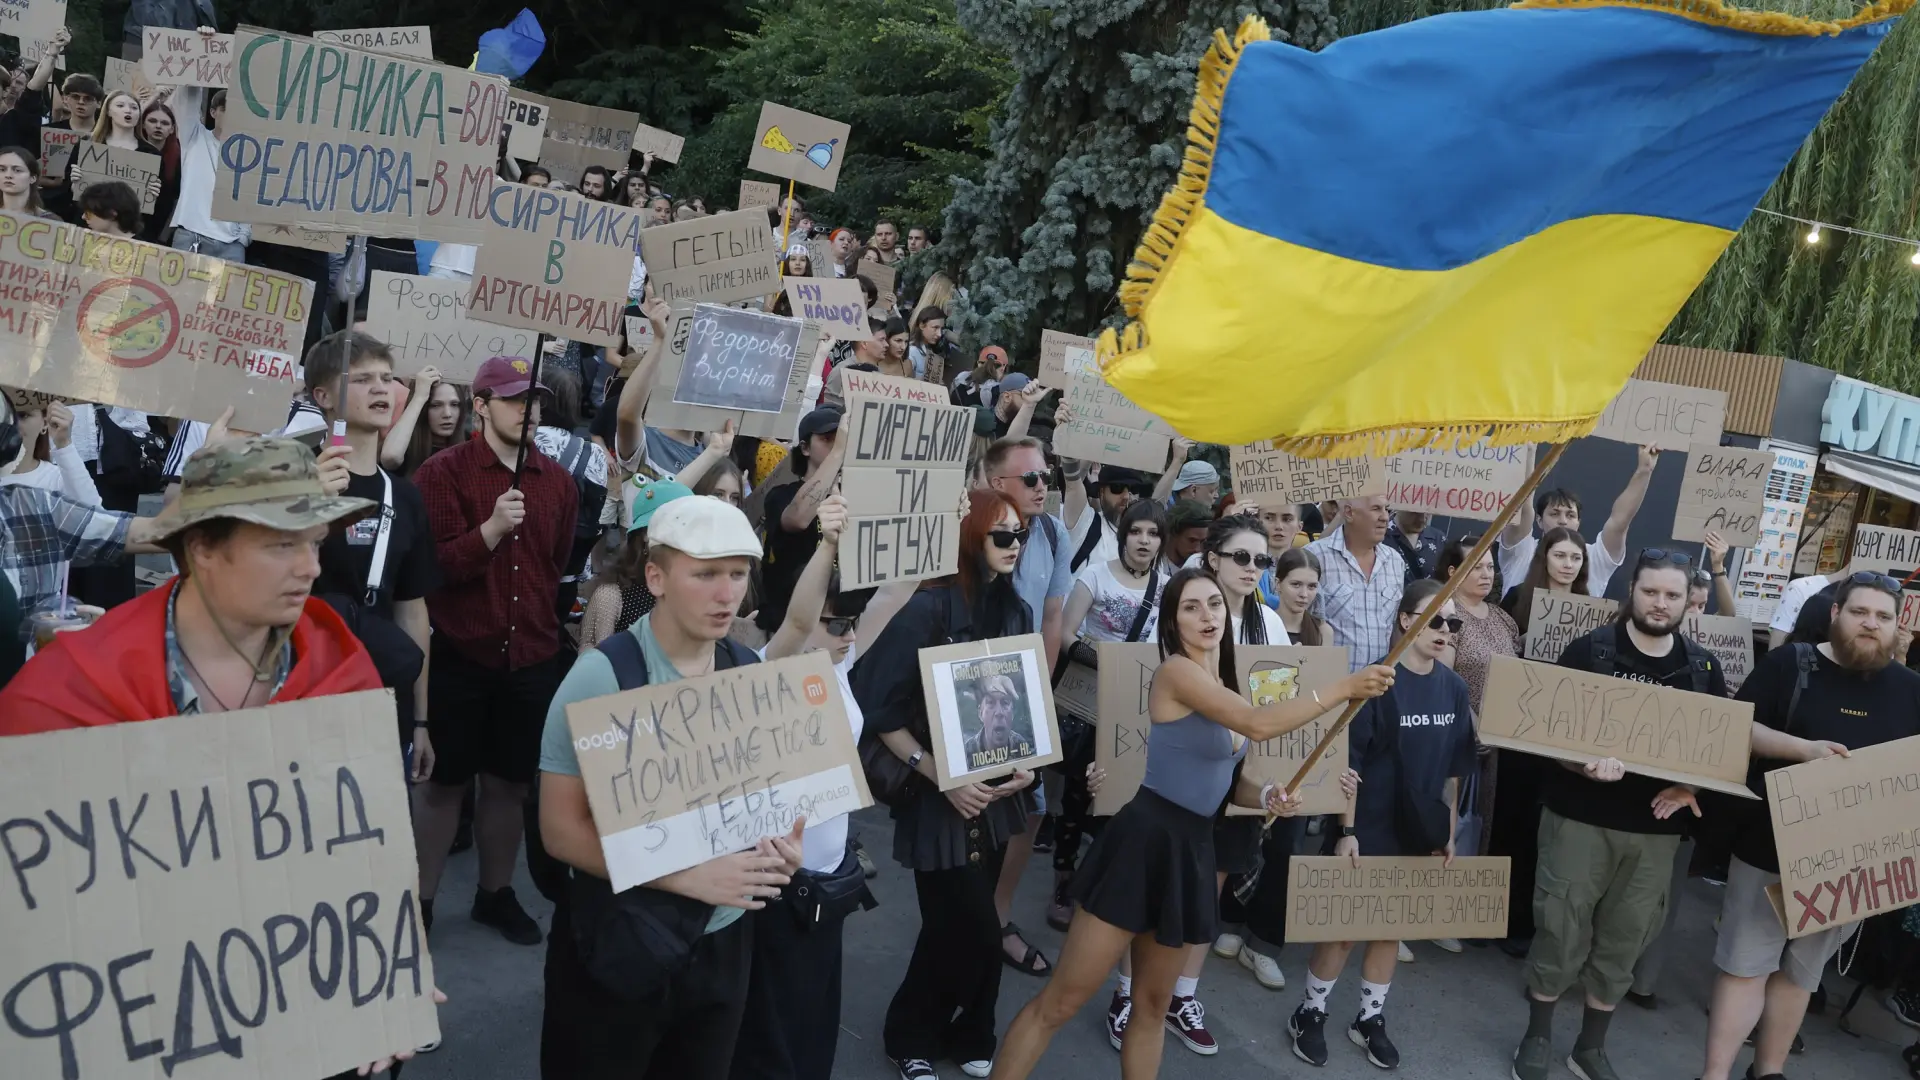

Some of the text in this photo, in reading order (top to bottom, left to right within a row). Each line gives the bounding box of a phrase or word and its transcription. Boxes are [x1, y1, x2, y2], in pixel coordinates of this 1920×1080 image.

[148, 32, 229, 54] У НАС ТЕЖ
[490, 186, 640, 251] СИРНИКА
[544, 239, 566, 285] В
[673, 226, 765, 269] ГЕТЬ!!!
[700, 266, 770, 295] ПАРМЕЗАНА
[796, 284, 822, 302] НУ
[195, 301, 286, 337] РЕПРЕСІЯ
[470, 275, 625, 336] АРТСНАРЯДИ
[803, 302, 863, 331] НАШО?
[182, 314, 289, 351] ВІЙСЬКОВИХ
[694, 316, 793, 364] Федорова
[178, 336, 295, 385] ЦЕ ГАНЬБА
[855, 401, 971, 462] СИРСЬКИЙ
[1820, 370, 1920, 464] КУП
[1385, 457, 1402, 473] НЕ
[1411, 459, 1493, 481] ПЕРЕМОЖЕ
[1777, 455, 1806, 470] КУПАЖ
[895, 468, 929, 513] ТИ
[1284, 480, 1365, 505] КВАРТАЛ?
[1446, 487, 1512, 513] СОВОК
[857, 514, 944, 584] ПЕТУХ!
[1853, 530, 1886, 560] КУРС
[1886, 533, 1905, 562] НА
[1538, 597, 1555, 620] У
[1707, 634, 1747, 649] ЛЮДИНА
[574, 723, 629, 750] oogle
[609, 671, 798, 766] УКРАЇНА
[1400, 713, 1455, 727] ЩОБ ЩО?
[971, 746, 1009, 767] ПОСАДУ
[686, 771, 788, 840] ТЕБЕ
[0, 785, 221, 911] РУКИ
[1294, 893, 1506, 926] РОЗГОРТАЄТЬСЯ ЗАМЕНА
[1793, 856, 1919, 933] ХУЙНЮ
[1, 889, 423, 1080] ФЕДОРОВА
